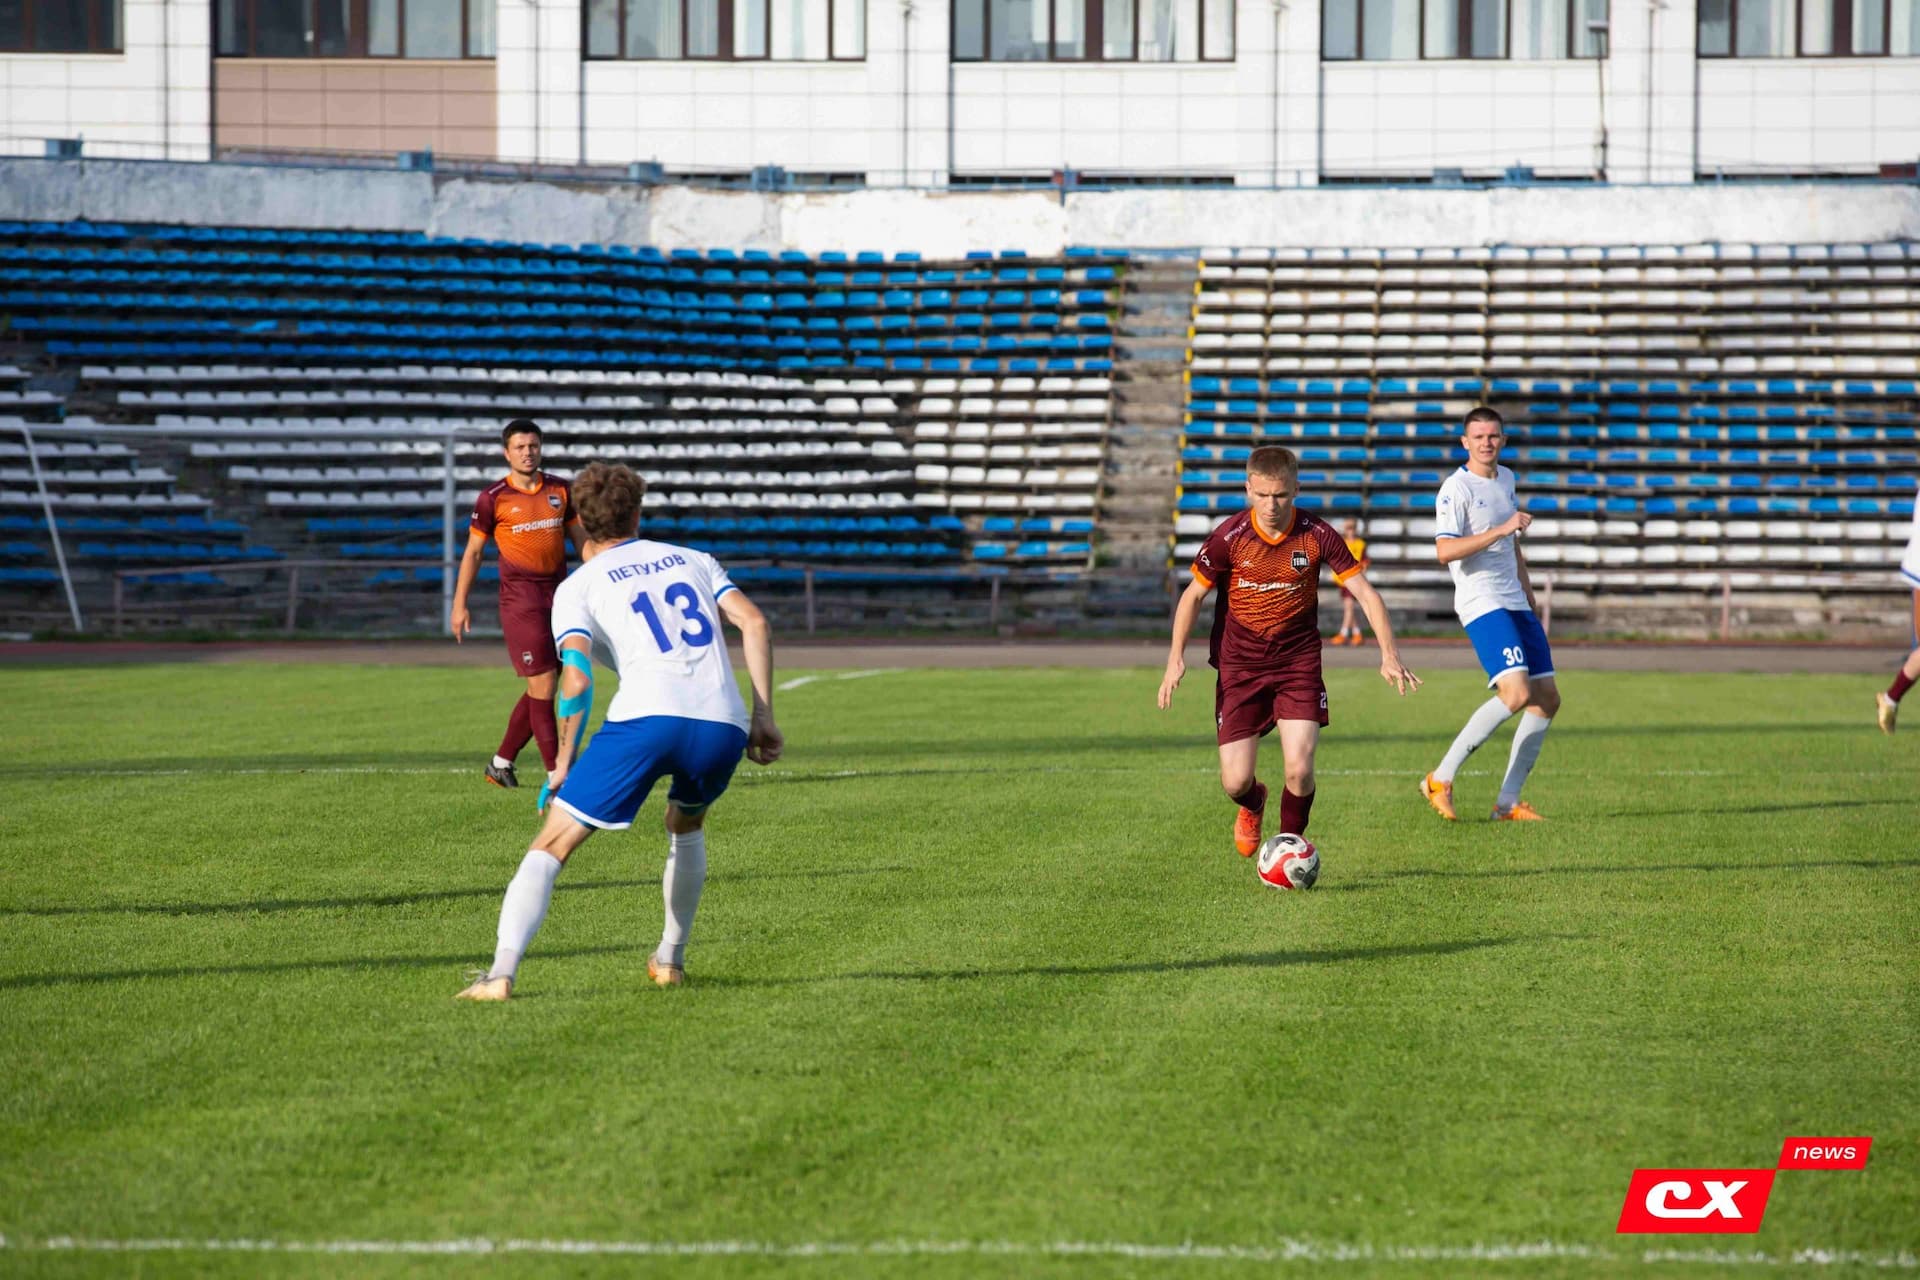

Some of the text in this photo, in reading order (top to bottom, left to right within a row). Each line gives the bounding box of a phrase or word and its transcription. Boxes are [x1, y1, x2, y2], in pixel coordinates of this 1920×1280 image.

[607, 554, 686, 583] ПЕТУХОВ
[631, 582, 713, 653] 13
[1502, 646, 1524, 666] 30
